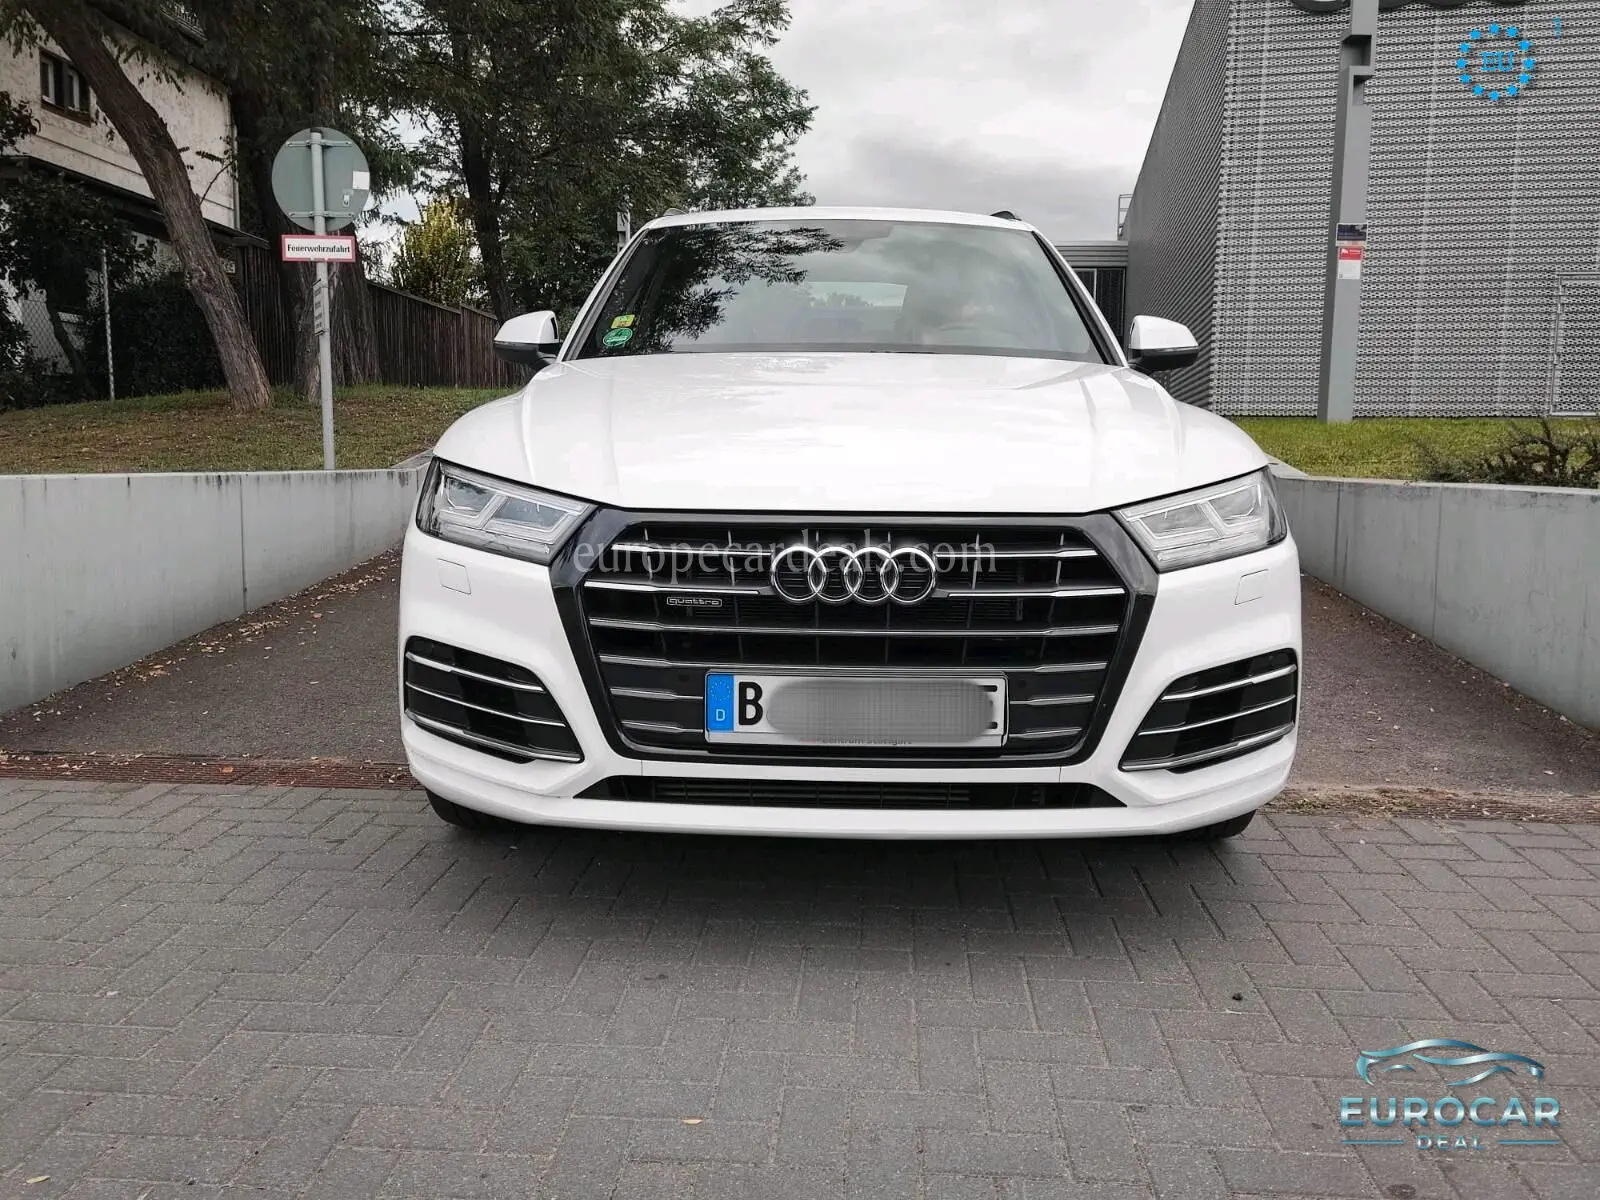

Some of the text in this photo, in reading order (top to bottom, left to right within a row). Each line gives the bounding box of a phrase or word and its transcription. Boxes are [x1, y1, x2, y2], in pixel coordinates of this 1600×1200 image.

[287, 244, 350, 253] Feuerwehrzufahrt
[668, 598, 720, 606] quattro
[738, 681, 763, 726] B
[715, 708, 726, 721] D
